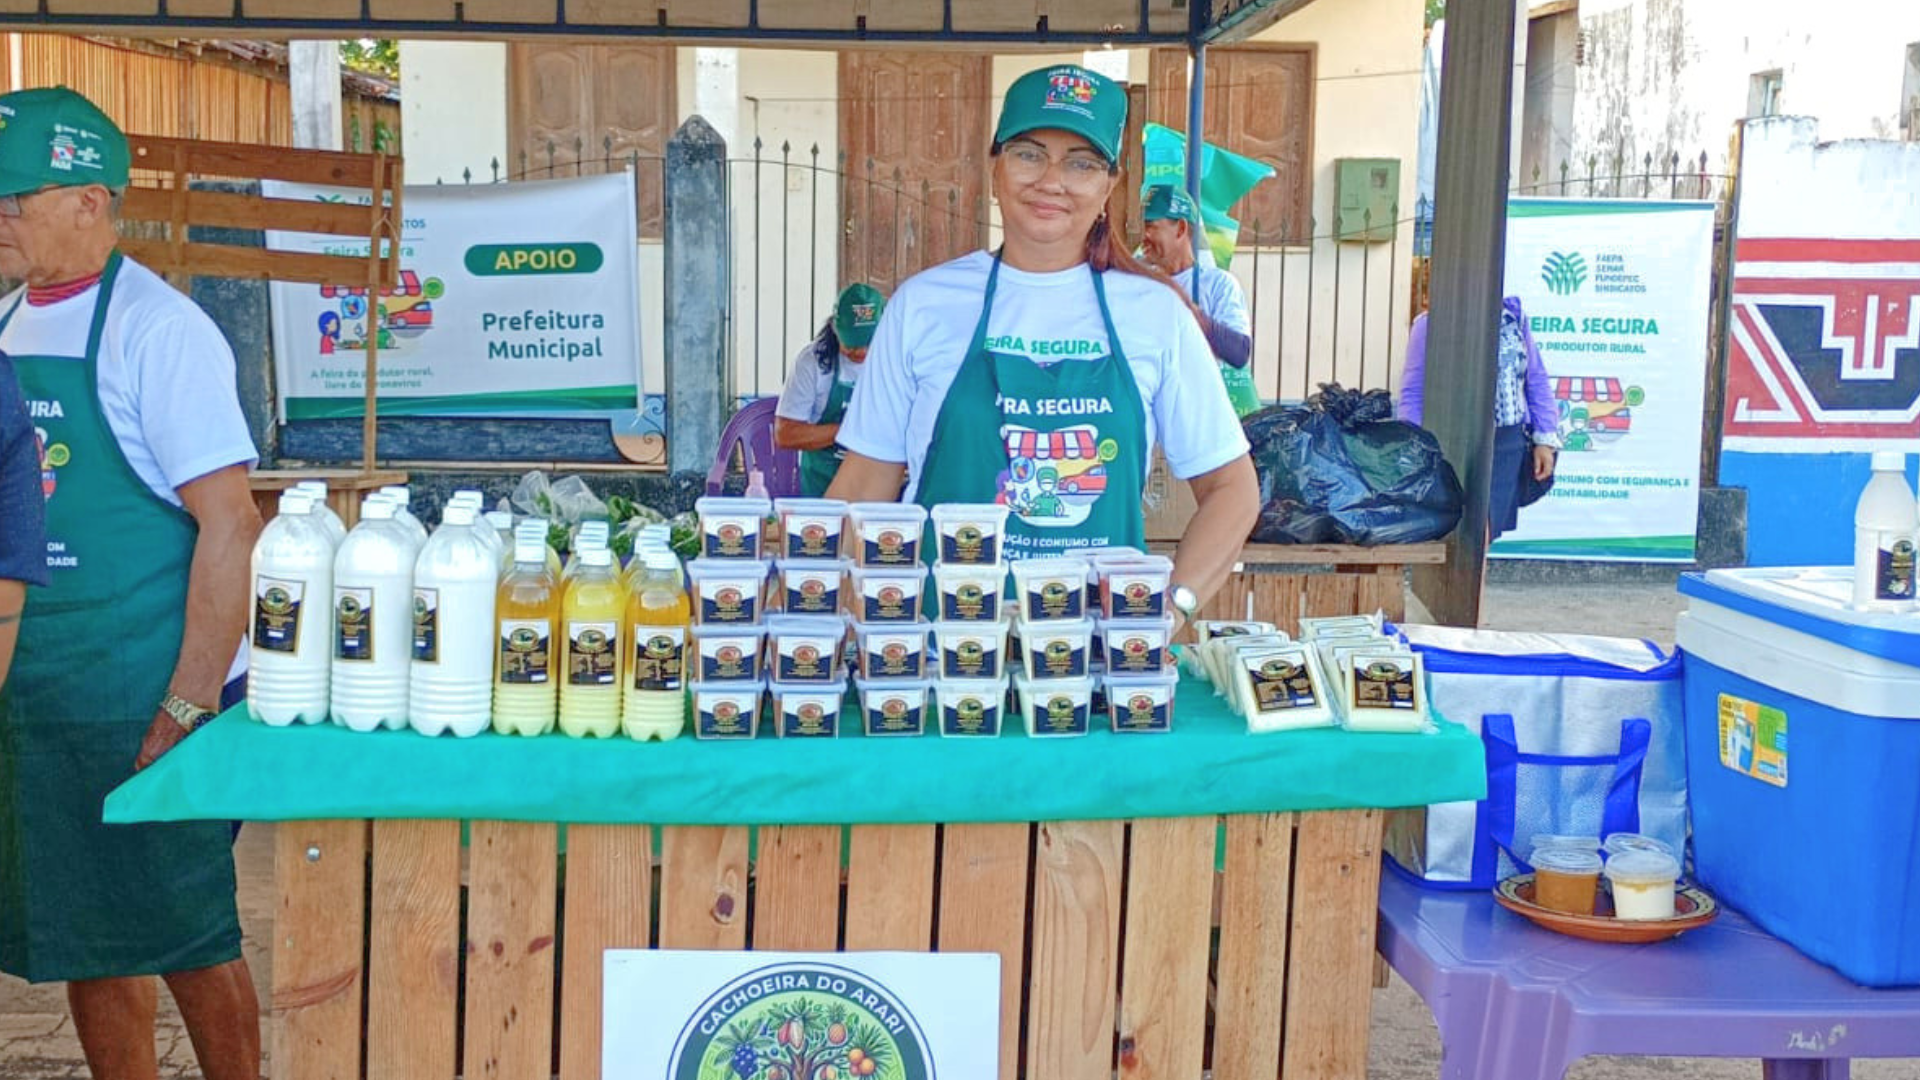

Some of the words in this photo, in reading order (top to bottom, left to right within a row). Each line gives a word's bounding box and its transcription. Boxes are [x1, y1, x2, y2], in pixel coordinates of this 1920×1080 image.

[495, 249, 577, 270] APOIO
[1595, 284, 1647, 293] SINDICATOS
[482, 310, 604, 331] Prefeitura
[1531, 316, 1576, 333] EIRA
[1582, 317, 1659, 335] SEGURA
[488, 337, 602, 361] Municipal
[1031, 339, 1103, 355] SEGURA
[1546, 341, 1607, 352] PRODUTOR
[1610, 343, 1646, 354] RURAL
[1036, 397, 1113, 415] SEGURA
[1597, 476, 1619, 485] COM
[700, 974, 810, 1035] CACHOEIRA
[816, 975, 847, 994] DO
[850, 987, 905, 1035] ARARI
